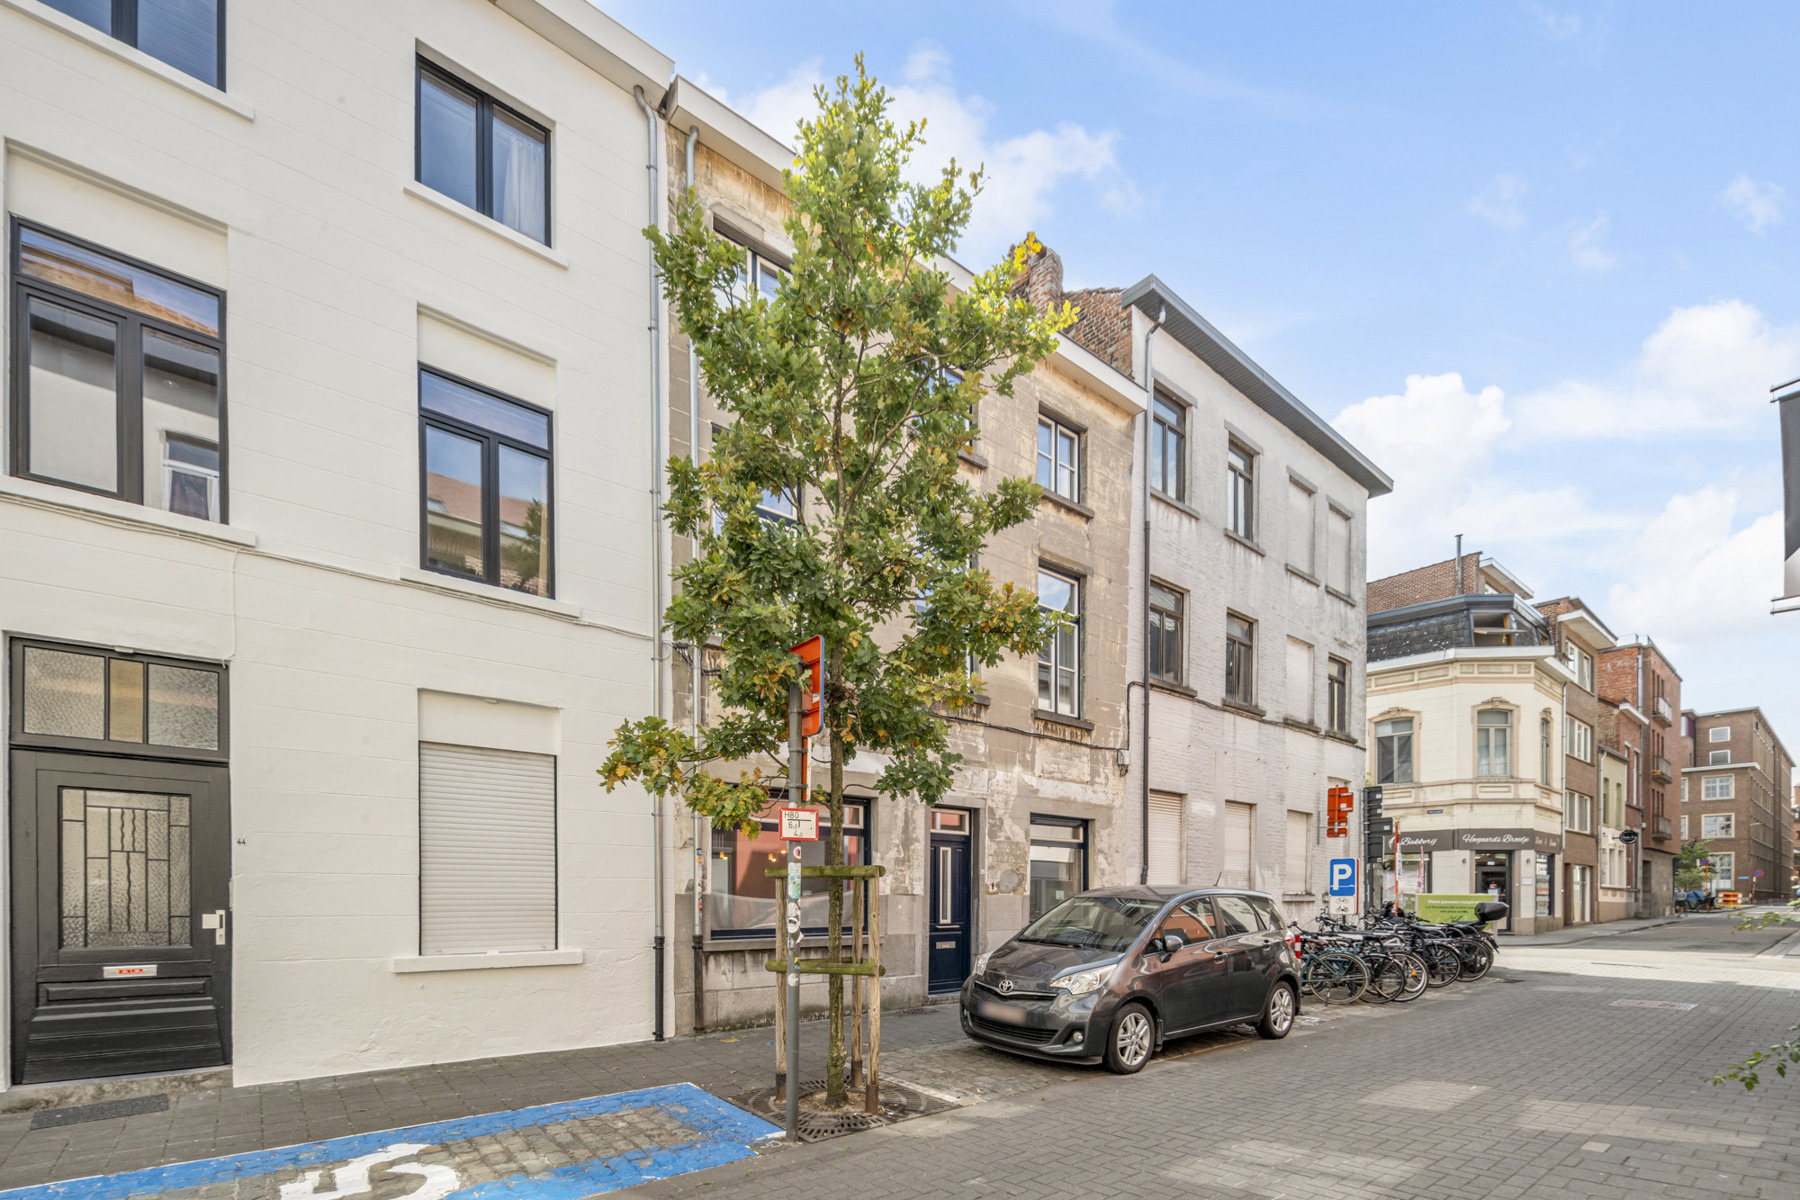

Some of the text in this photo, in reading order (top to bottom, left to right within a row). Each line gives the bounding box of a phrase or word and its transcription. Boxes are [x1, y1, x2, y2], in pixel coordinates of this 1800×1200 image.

[784, 811, 800, 819] H80
[1400, 837, 1438, 846] Bakkerij
[1333, 864, 1353, 890] P
